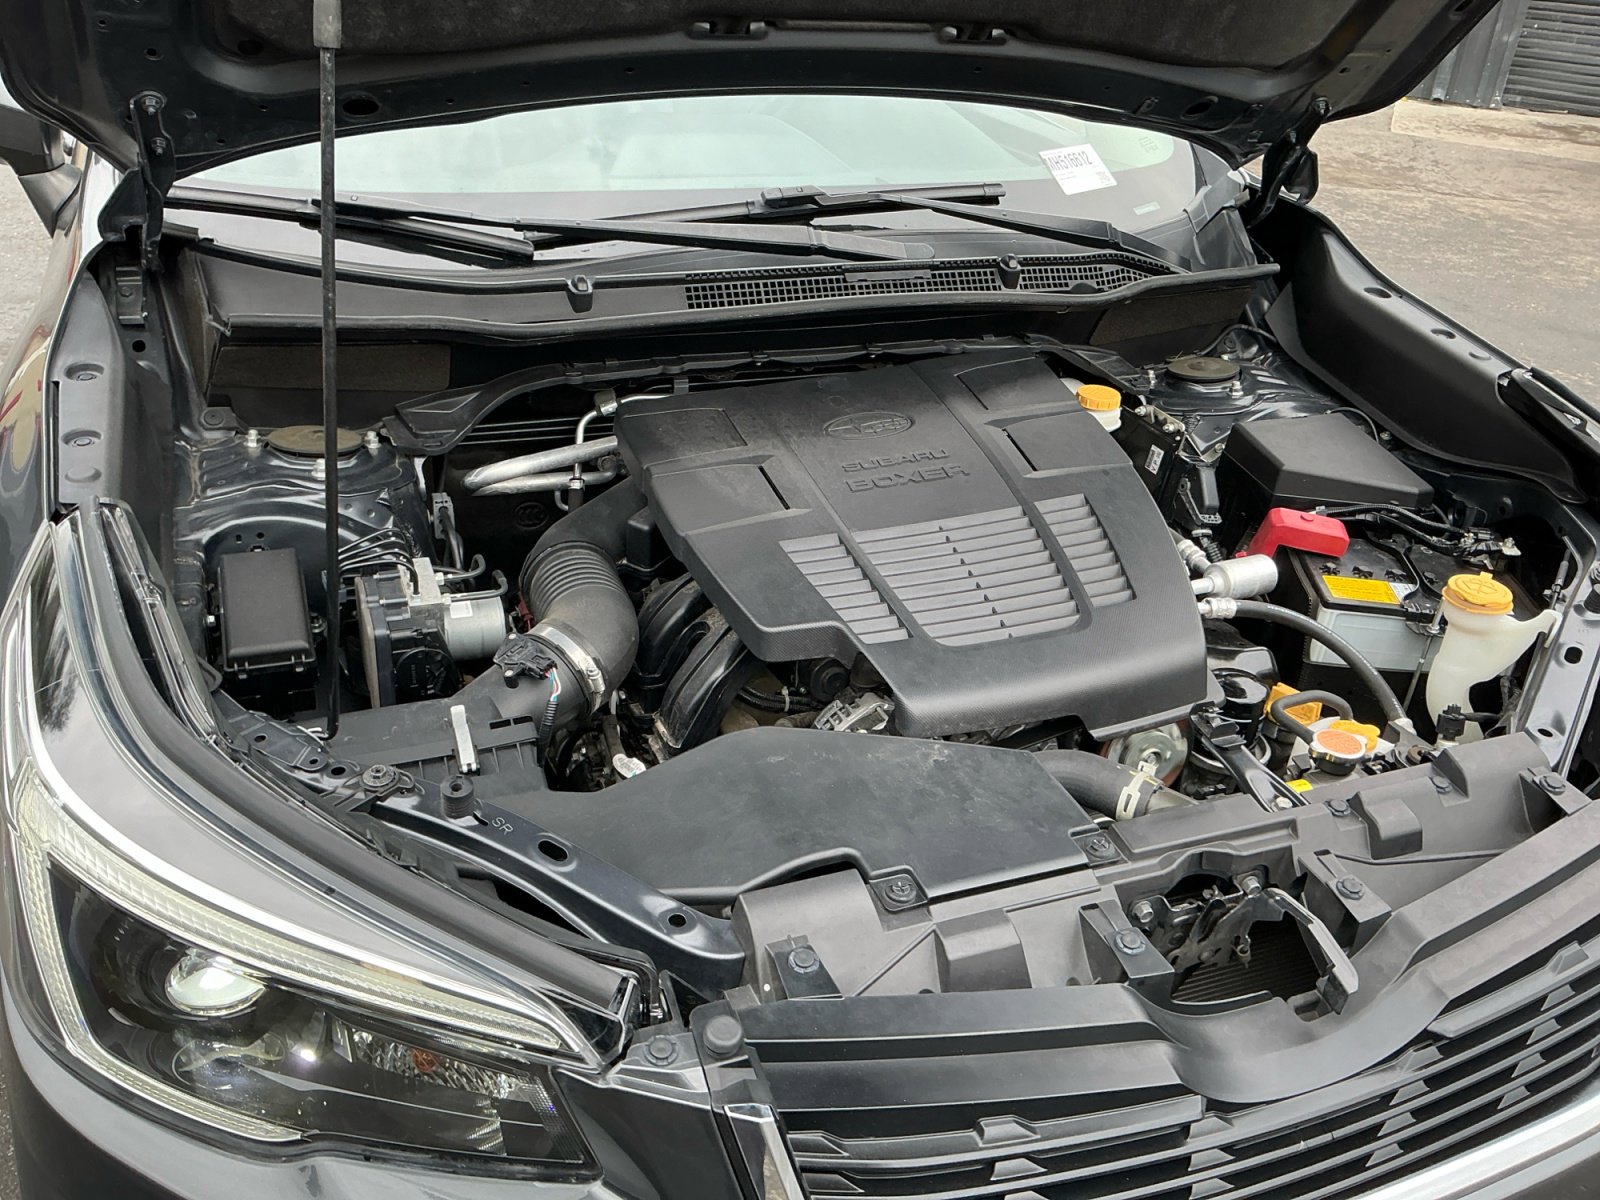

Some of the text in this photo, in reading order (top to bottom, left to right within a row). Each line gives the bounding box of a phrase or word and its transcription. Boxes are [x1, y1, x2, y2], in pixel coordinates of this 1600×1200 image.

[841, 448, 950, 472] SUBARU
[843, 464, 971, 493] BOXER
[491, 816, 514, 836] SR
